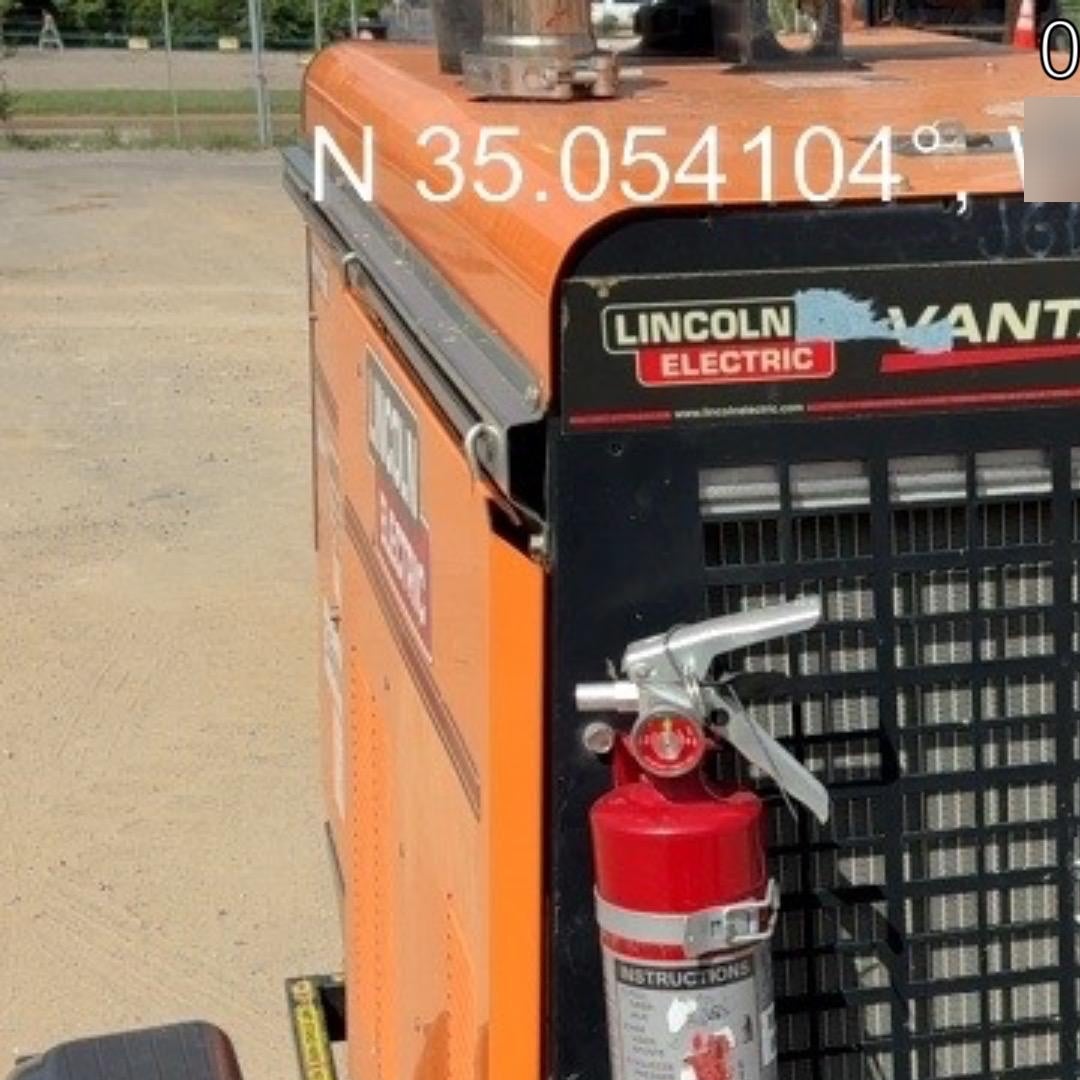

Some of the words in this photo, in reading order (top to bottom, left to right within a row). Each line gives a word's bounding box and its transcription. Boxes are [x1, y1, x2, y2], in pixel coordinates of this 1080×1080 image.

[614, 305, 791, 346] LINCOLN
[660, 346, 815, 377] ELECTRIC
[620, 959, 752, 988] INSTRUCTIONS
